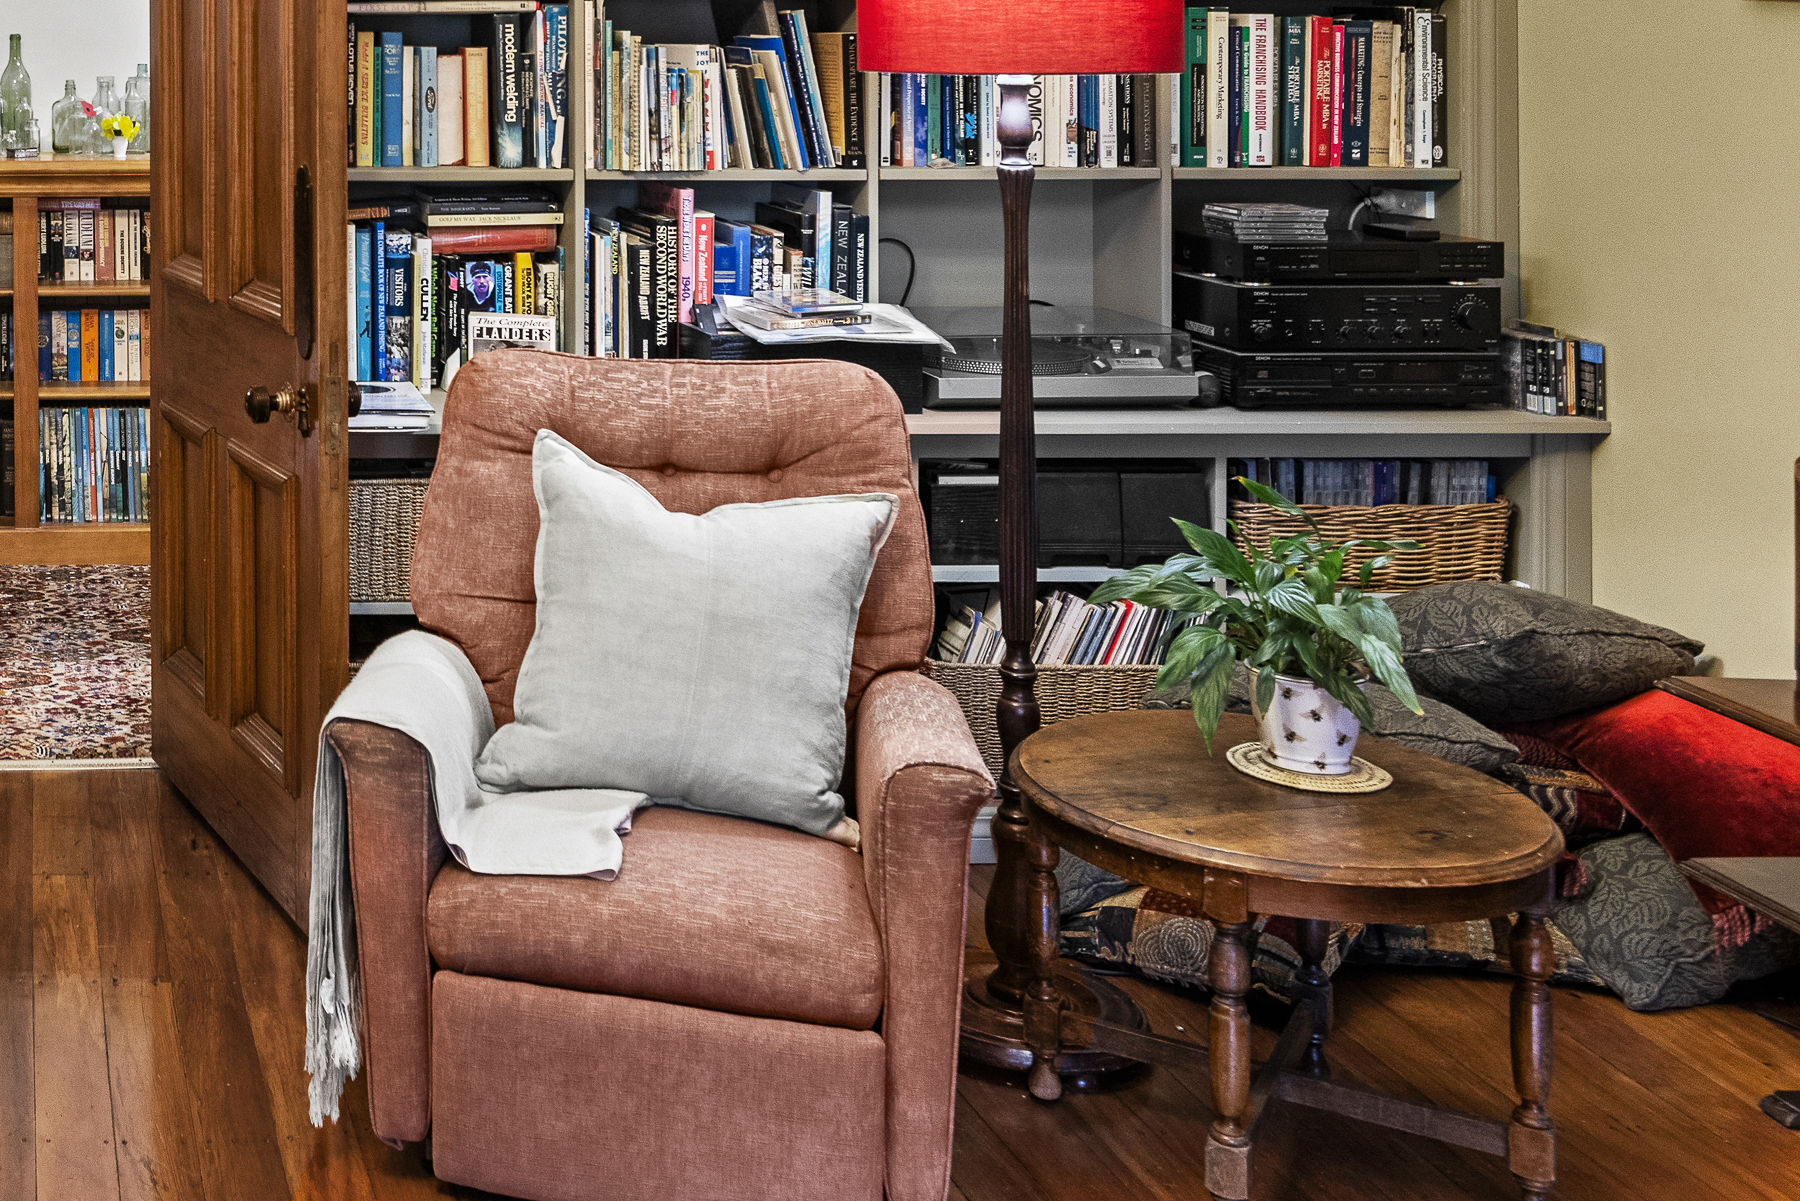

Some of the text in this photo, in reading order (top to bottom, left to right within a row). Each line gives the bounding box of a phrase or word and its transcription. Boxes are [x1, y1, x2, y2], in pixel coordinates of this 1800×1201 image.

[504, 22, 519, 121] modern welding
[1214, 35, 1225, 119] Contemporary Marketing
[1255, 16, 1267, 130] THE FRANCHISING HANDBOOK
[1417, 14, 1431, 101] Environmental Science
[360, 69, 369, 144] SERVICE BULLETINS
[80, 211, 93, 247] LUDLUM
[697, 234, 708, 282] New Zealand
[395, 268, 405, 307] VISITORS
[419, 278, 429, 322] CULLEN
[655, 224, 667, 346] SECOND WORLD WAR
[666, 225, 677, 323] HISTORY OF THE
[752, 258, 764, 290] BLACK
[474, 326, 552, 340] FLANDERS
